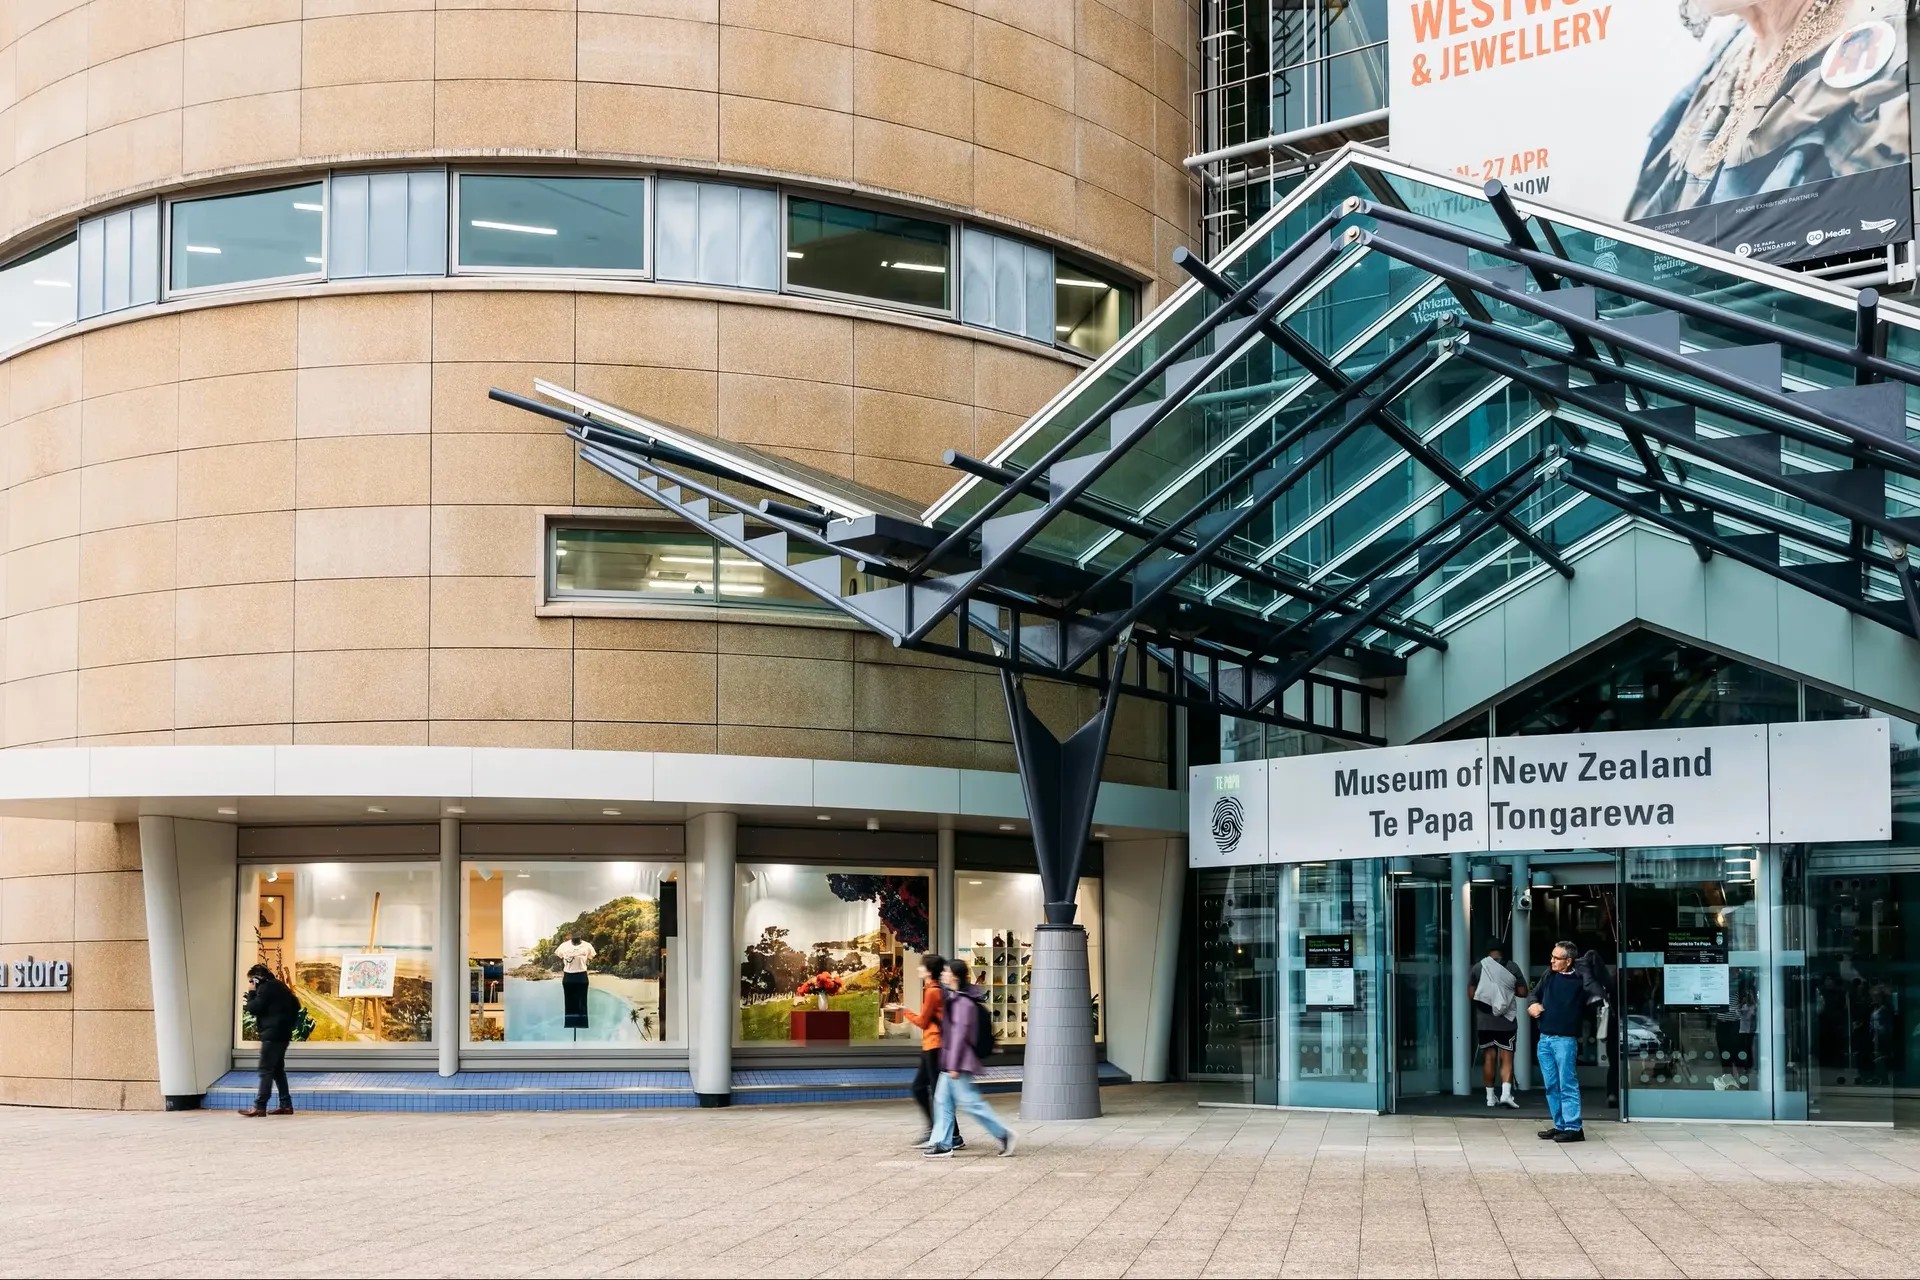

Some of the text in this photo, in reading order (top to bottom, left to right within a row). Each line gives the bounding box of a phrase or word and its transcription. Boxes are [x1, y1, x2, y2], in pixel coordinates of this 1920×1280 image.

[1411, 0, 1580, 43] WEST
[1411, 5, 1612, 87] & JEWELLERY
[1483, 157, 1505, 181] 27
[1510, 148, 1549, 176] APR
[1735, 192, 1819, 214] MAJOR EXHIBITION PARTNERS
[1654, 219, 1690, 231] DESTINATION
[1825, 228, 1851, 239] Media
[1753, 241, 1797, 253] FOUNDATION
[1653, 259, 1687, 272] Welling
[1335, 747, 1712, 797] Museum of New Zealand
[1369, 801, 1675, 841] Te Papa Tongarewa
[14, 955, 69, 988] store
